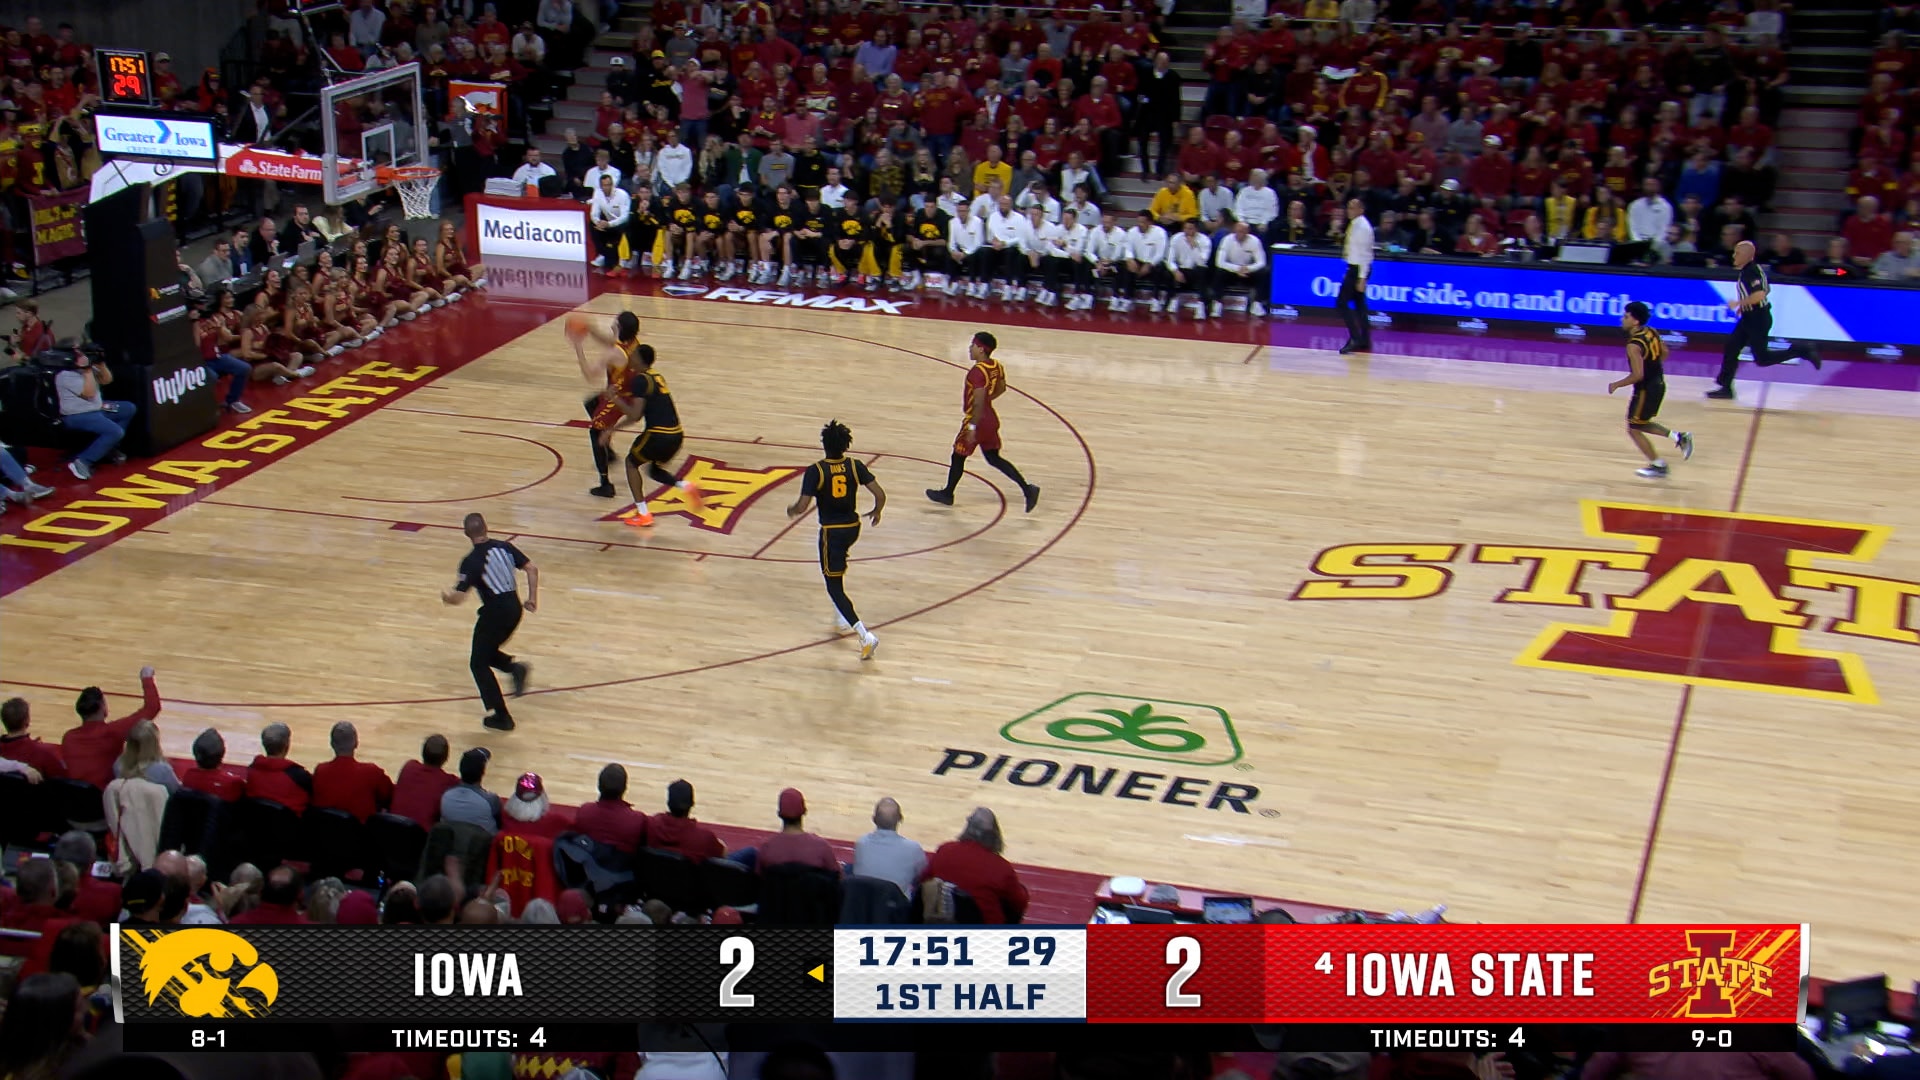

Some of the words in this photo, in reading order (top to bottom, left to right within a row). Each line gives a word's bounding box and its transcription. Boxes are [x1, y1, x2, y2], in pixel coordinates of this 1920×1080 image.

[110, 57, 144, 74] 17:51
[113, 74, 141, 97] 29
[104, 127, 156, 144] Greater
[175, 132, 207, 148] Iowa
[484, 219, 582, 245] Mediacom
[1365, 284, 1412, 302] our
[1412, 282, 1473, 309] side,
[1475, 291, 1510, 309] on
[1512, 290, 1564, 313] and
[1566, 292, 1610, 316] off
[152, 366, 206, 404] HyVee
[202, 361, 439, 454] STATE
[831, 475, 847, 498] 6
[0, 460, 251, 554] IOWA
[931, 747, 1262, 815] PIONEER
